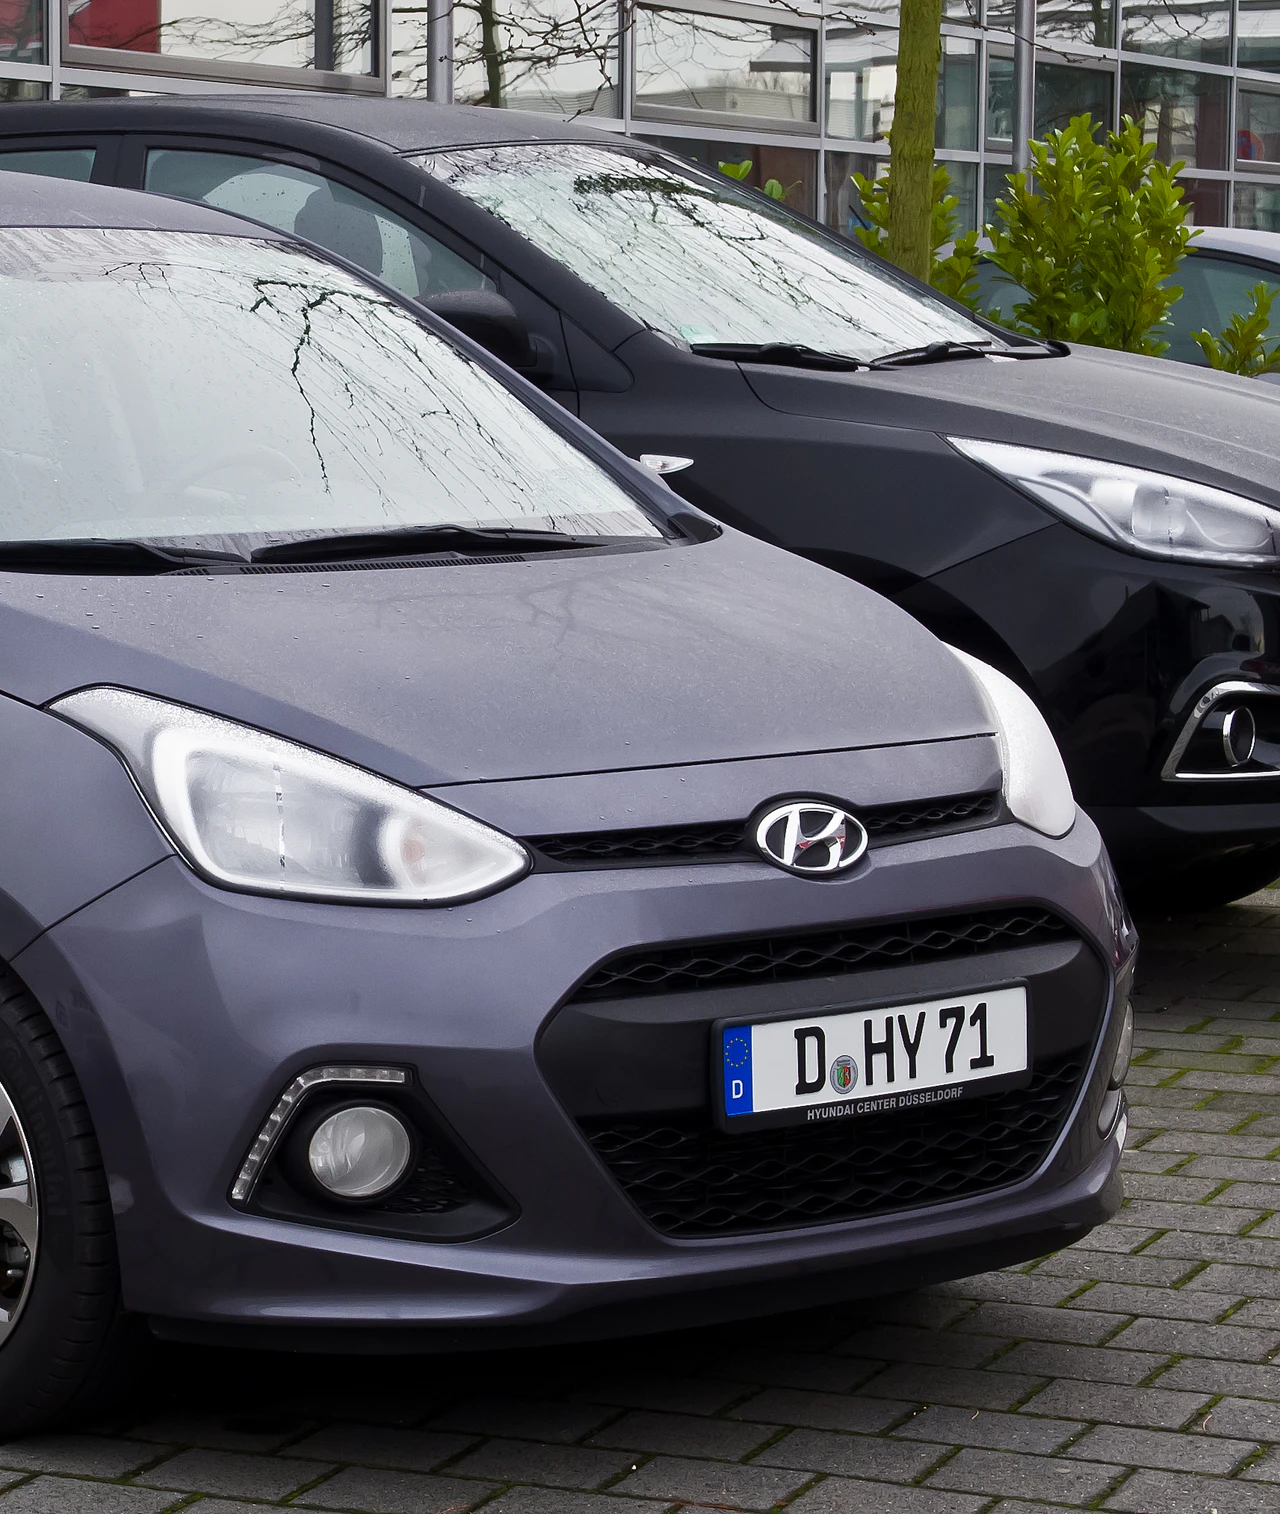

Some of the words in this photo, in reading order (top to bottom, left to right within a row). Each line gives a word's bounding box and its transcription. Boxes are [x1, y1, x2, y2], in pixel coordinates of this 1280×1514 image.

[793, 1025, 826, 1096] D
[863, 1011, 927, 1087] HY
[938, 1002, 995, 1074] 71
[731, 1079, 744, 1099] D
[807, 1103, 855, 1121] HYUNDAI
[856, 1097, 897, 1114] CENTER
[898, 1086, 964, 1108] DÜSSELDORF
